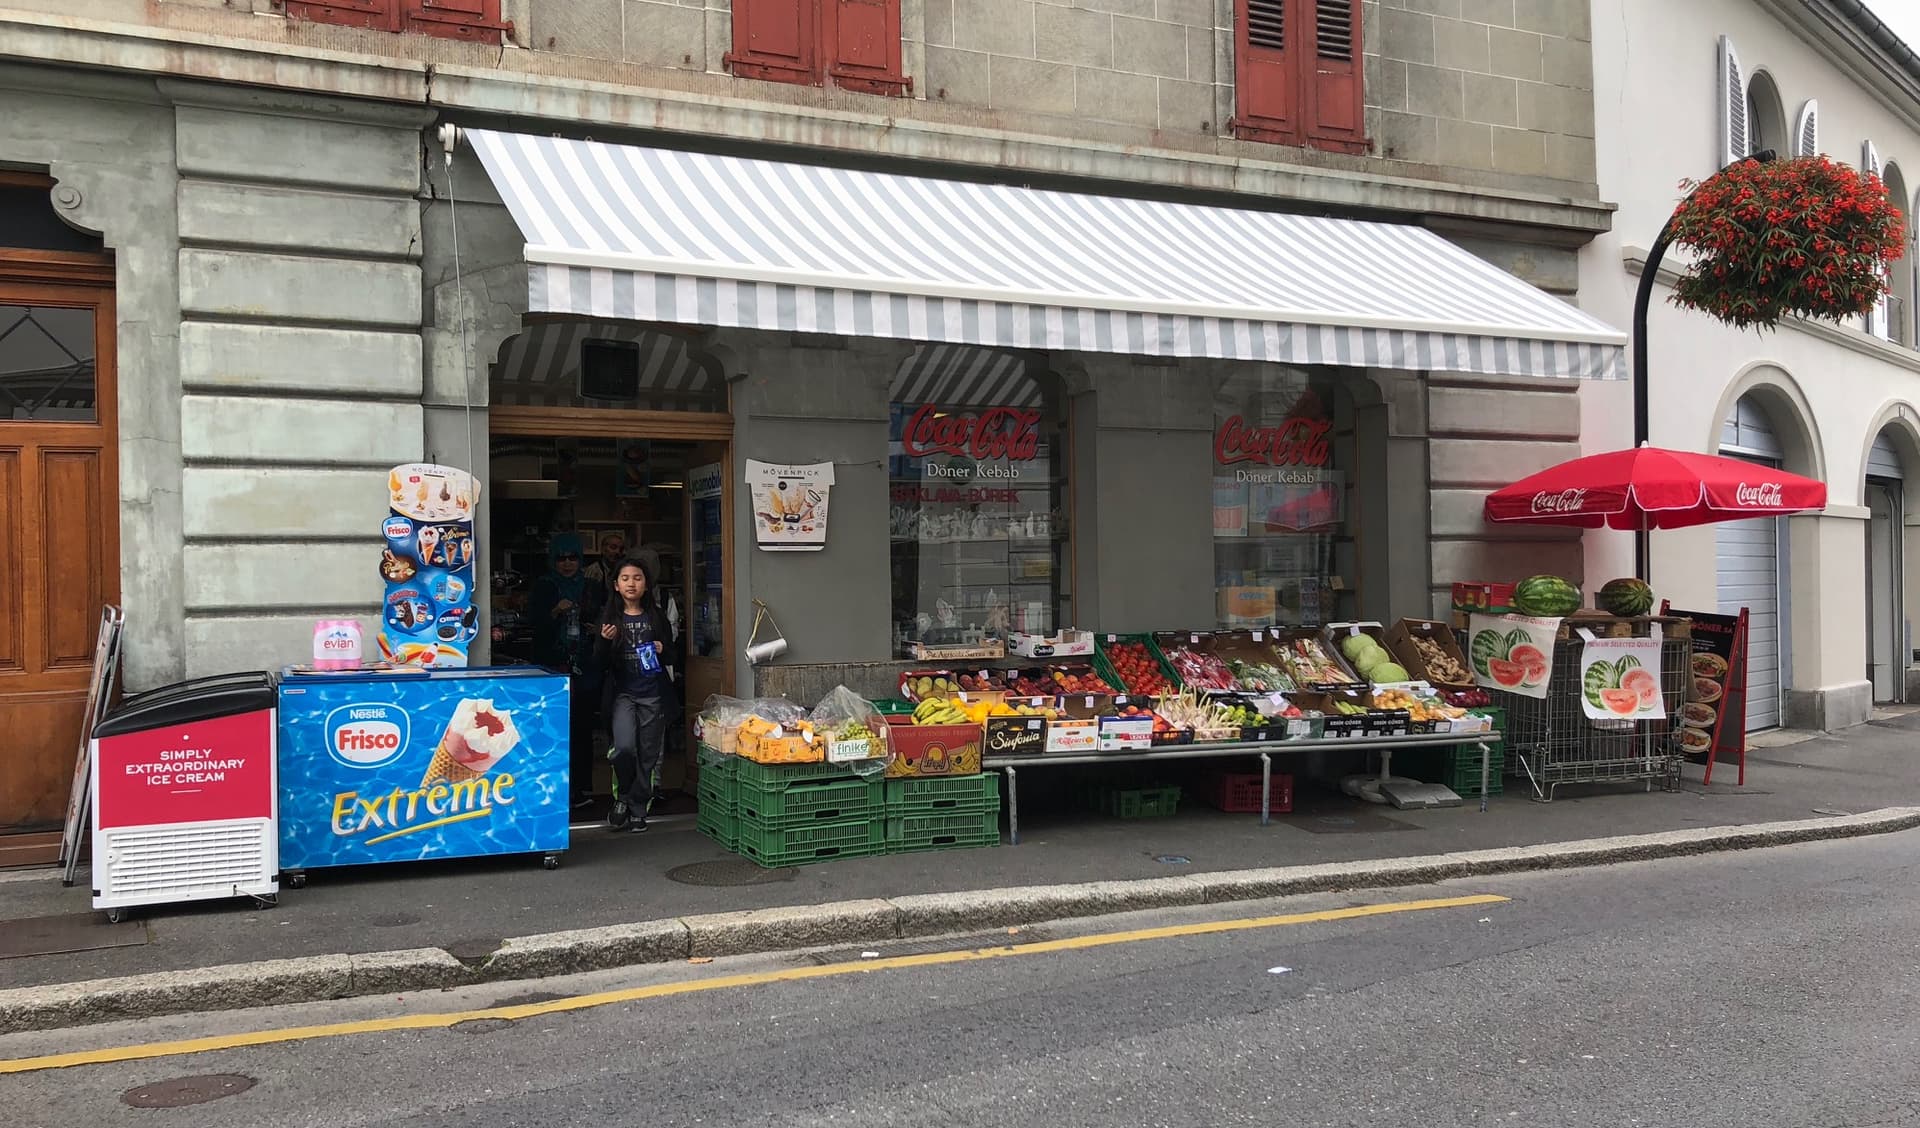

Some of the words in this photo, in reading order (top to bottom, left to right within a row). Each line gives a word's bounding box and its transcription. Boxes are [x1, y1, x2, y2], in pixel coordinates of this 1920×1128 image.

[903, 402, 1040, 460] Coca-Cola
[1216, 414, 1332, 467] Coca-Cola
[763, 468, 819, 476] MÖVENPICK
[927, 463, 970, 478] Döner
[976, 463, 1020, 479] Kebab
[1236, 470, 1273, 483] Döner
[1278, 470, 1315, 484] Kebab
[1532, 488, 1588, 512] Coca-Cola
[1736, 481, 1783, 507] Coca-Cola
[387, 526, 410, 535] Frisco
[324, 639, 354, 648] evian
[1637, 640, 1659, 648] QUALITY
[338, 730, 398, 750] Frisco
[990, 730, 1041, 751] Sinfonia
[160, 749, 212, 760] SIMPLY
[125, 759, 246, 775] EXTRAORDINARY
[147, 775, 171, 785] ICE
[175, 772, 225, 783] CREAM
[332, 773, 517, 836] Extrême
